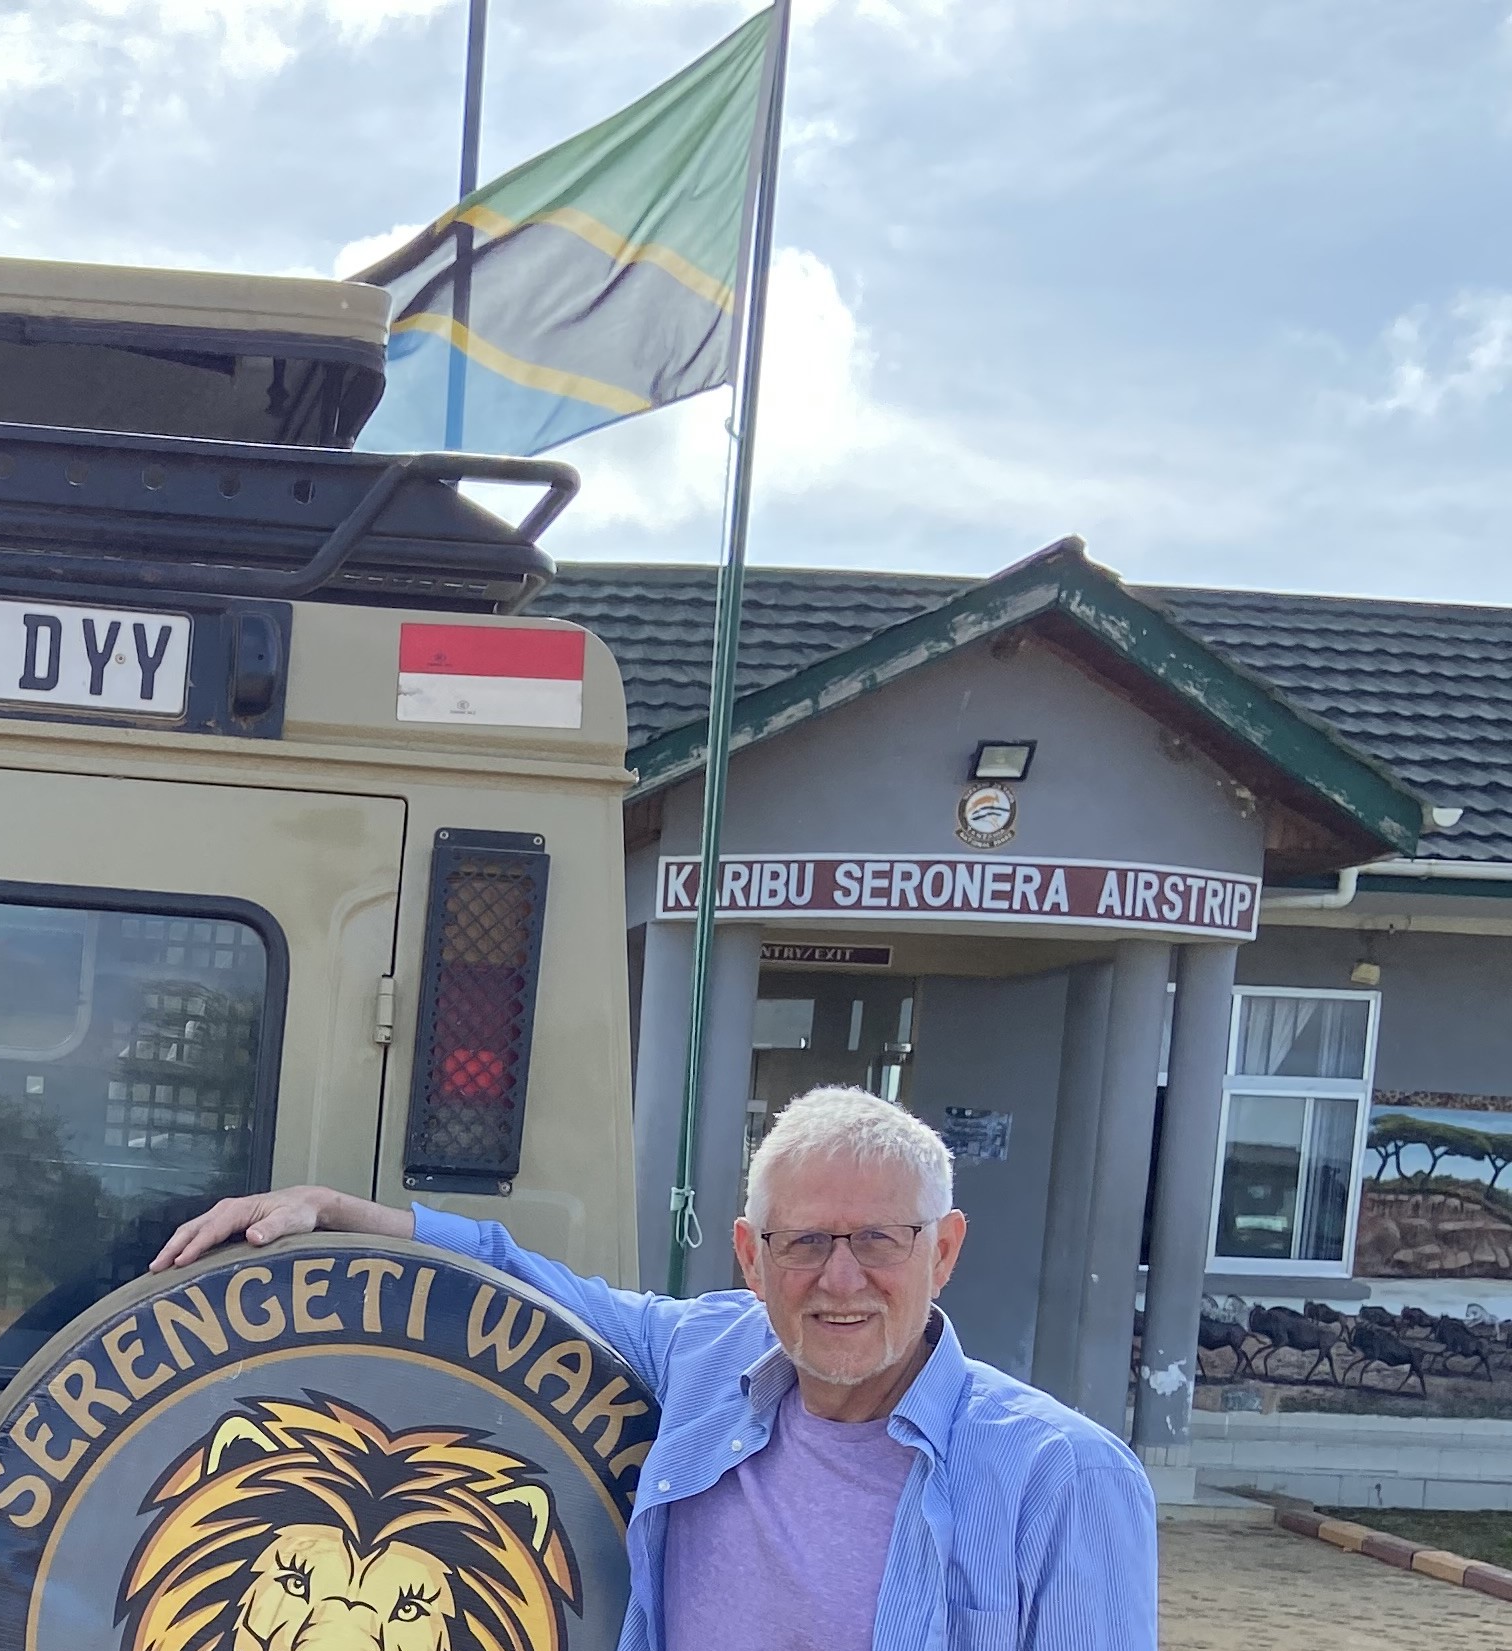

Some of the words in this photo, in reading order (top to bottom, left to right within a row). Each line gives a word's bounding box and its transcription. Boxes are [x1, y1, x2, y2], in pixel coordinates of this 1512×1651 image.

[18, 613, 172, 700] DYY
[833, 861, 1070, 913] SERONERA
[1097, 872, 1253, 929] AIRSTRIP
[760, 945, 854, 961] NTRY/EXIT
